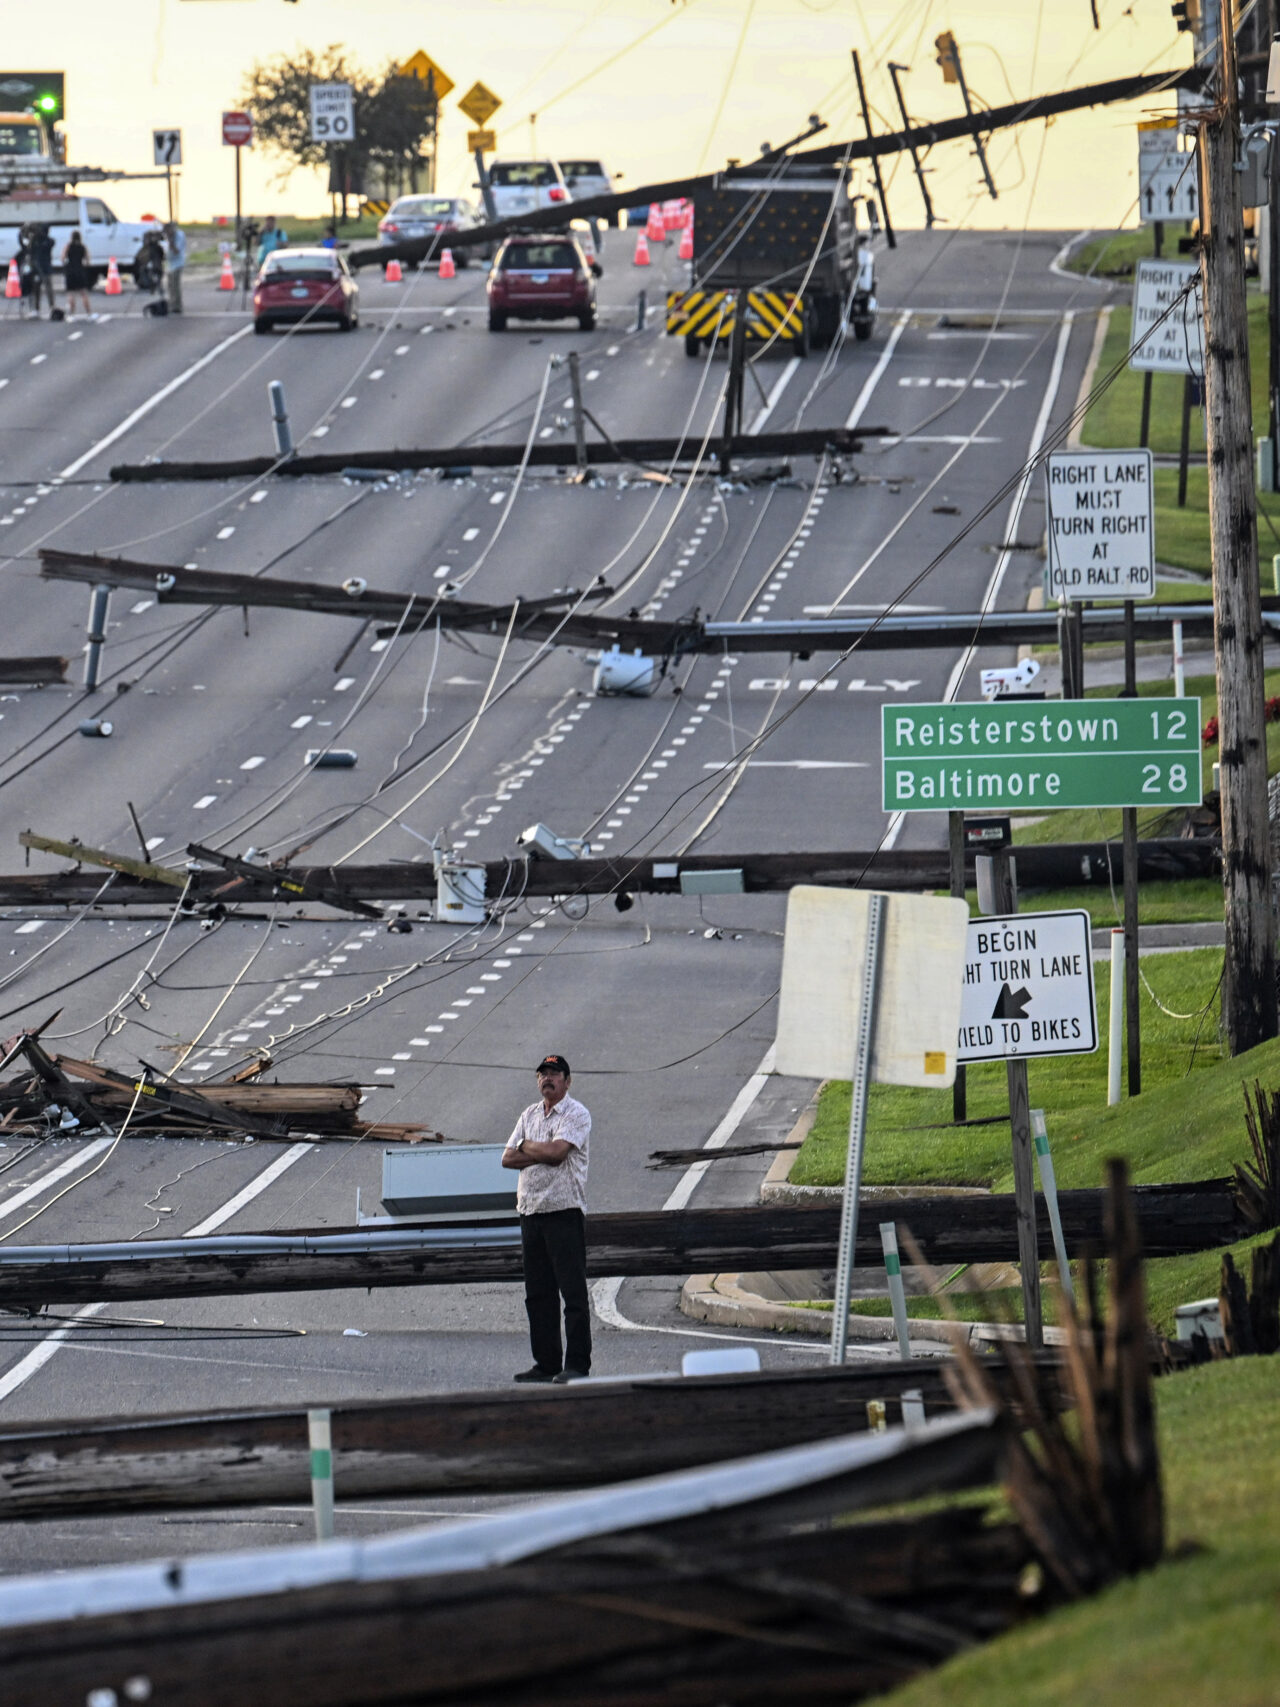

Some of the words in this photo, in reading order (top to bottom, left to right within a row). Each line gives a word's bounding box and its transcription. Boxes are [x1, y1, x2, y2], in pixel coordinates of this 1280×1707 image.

[316, 116, 348, 136] 50
[1140, 268, 1175, 285] RIGHT
[1164, 328, 1177, 342] AT
[898, 376, 1027, 388] ONLY
[1052, 465, 1097, 484] RIGHT
[1105, 464, 1146, 484] LANE
[1076, 490, 1122, 510] MUST
[1053, 517, 1094, 536] TURN
[1101, 515, 1147, 535] RIGHT
[1092, 542, 1108, 560] AT
[1054, 568, 1082, 586] OLD
[1130, 567, 1150, 584] RD
[748, 678, 922, 692] ONLY
[895, 714, 1119, 746] Reisterstown
[1150, 710, 1187, 740] 12
[895, 768, 1061, 799] Baltimore
[1141, 763, 1187, 793] 28
[977, 929, 1036, 954] BEGIN
[990, 959, 1031, 982] TURN
[1041, 955, 1082, 978] LANE
[1001, 1022, 1020, 1043] TO
[1031, 1018, 1081, 1041] BIKES
